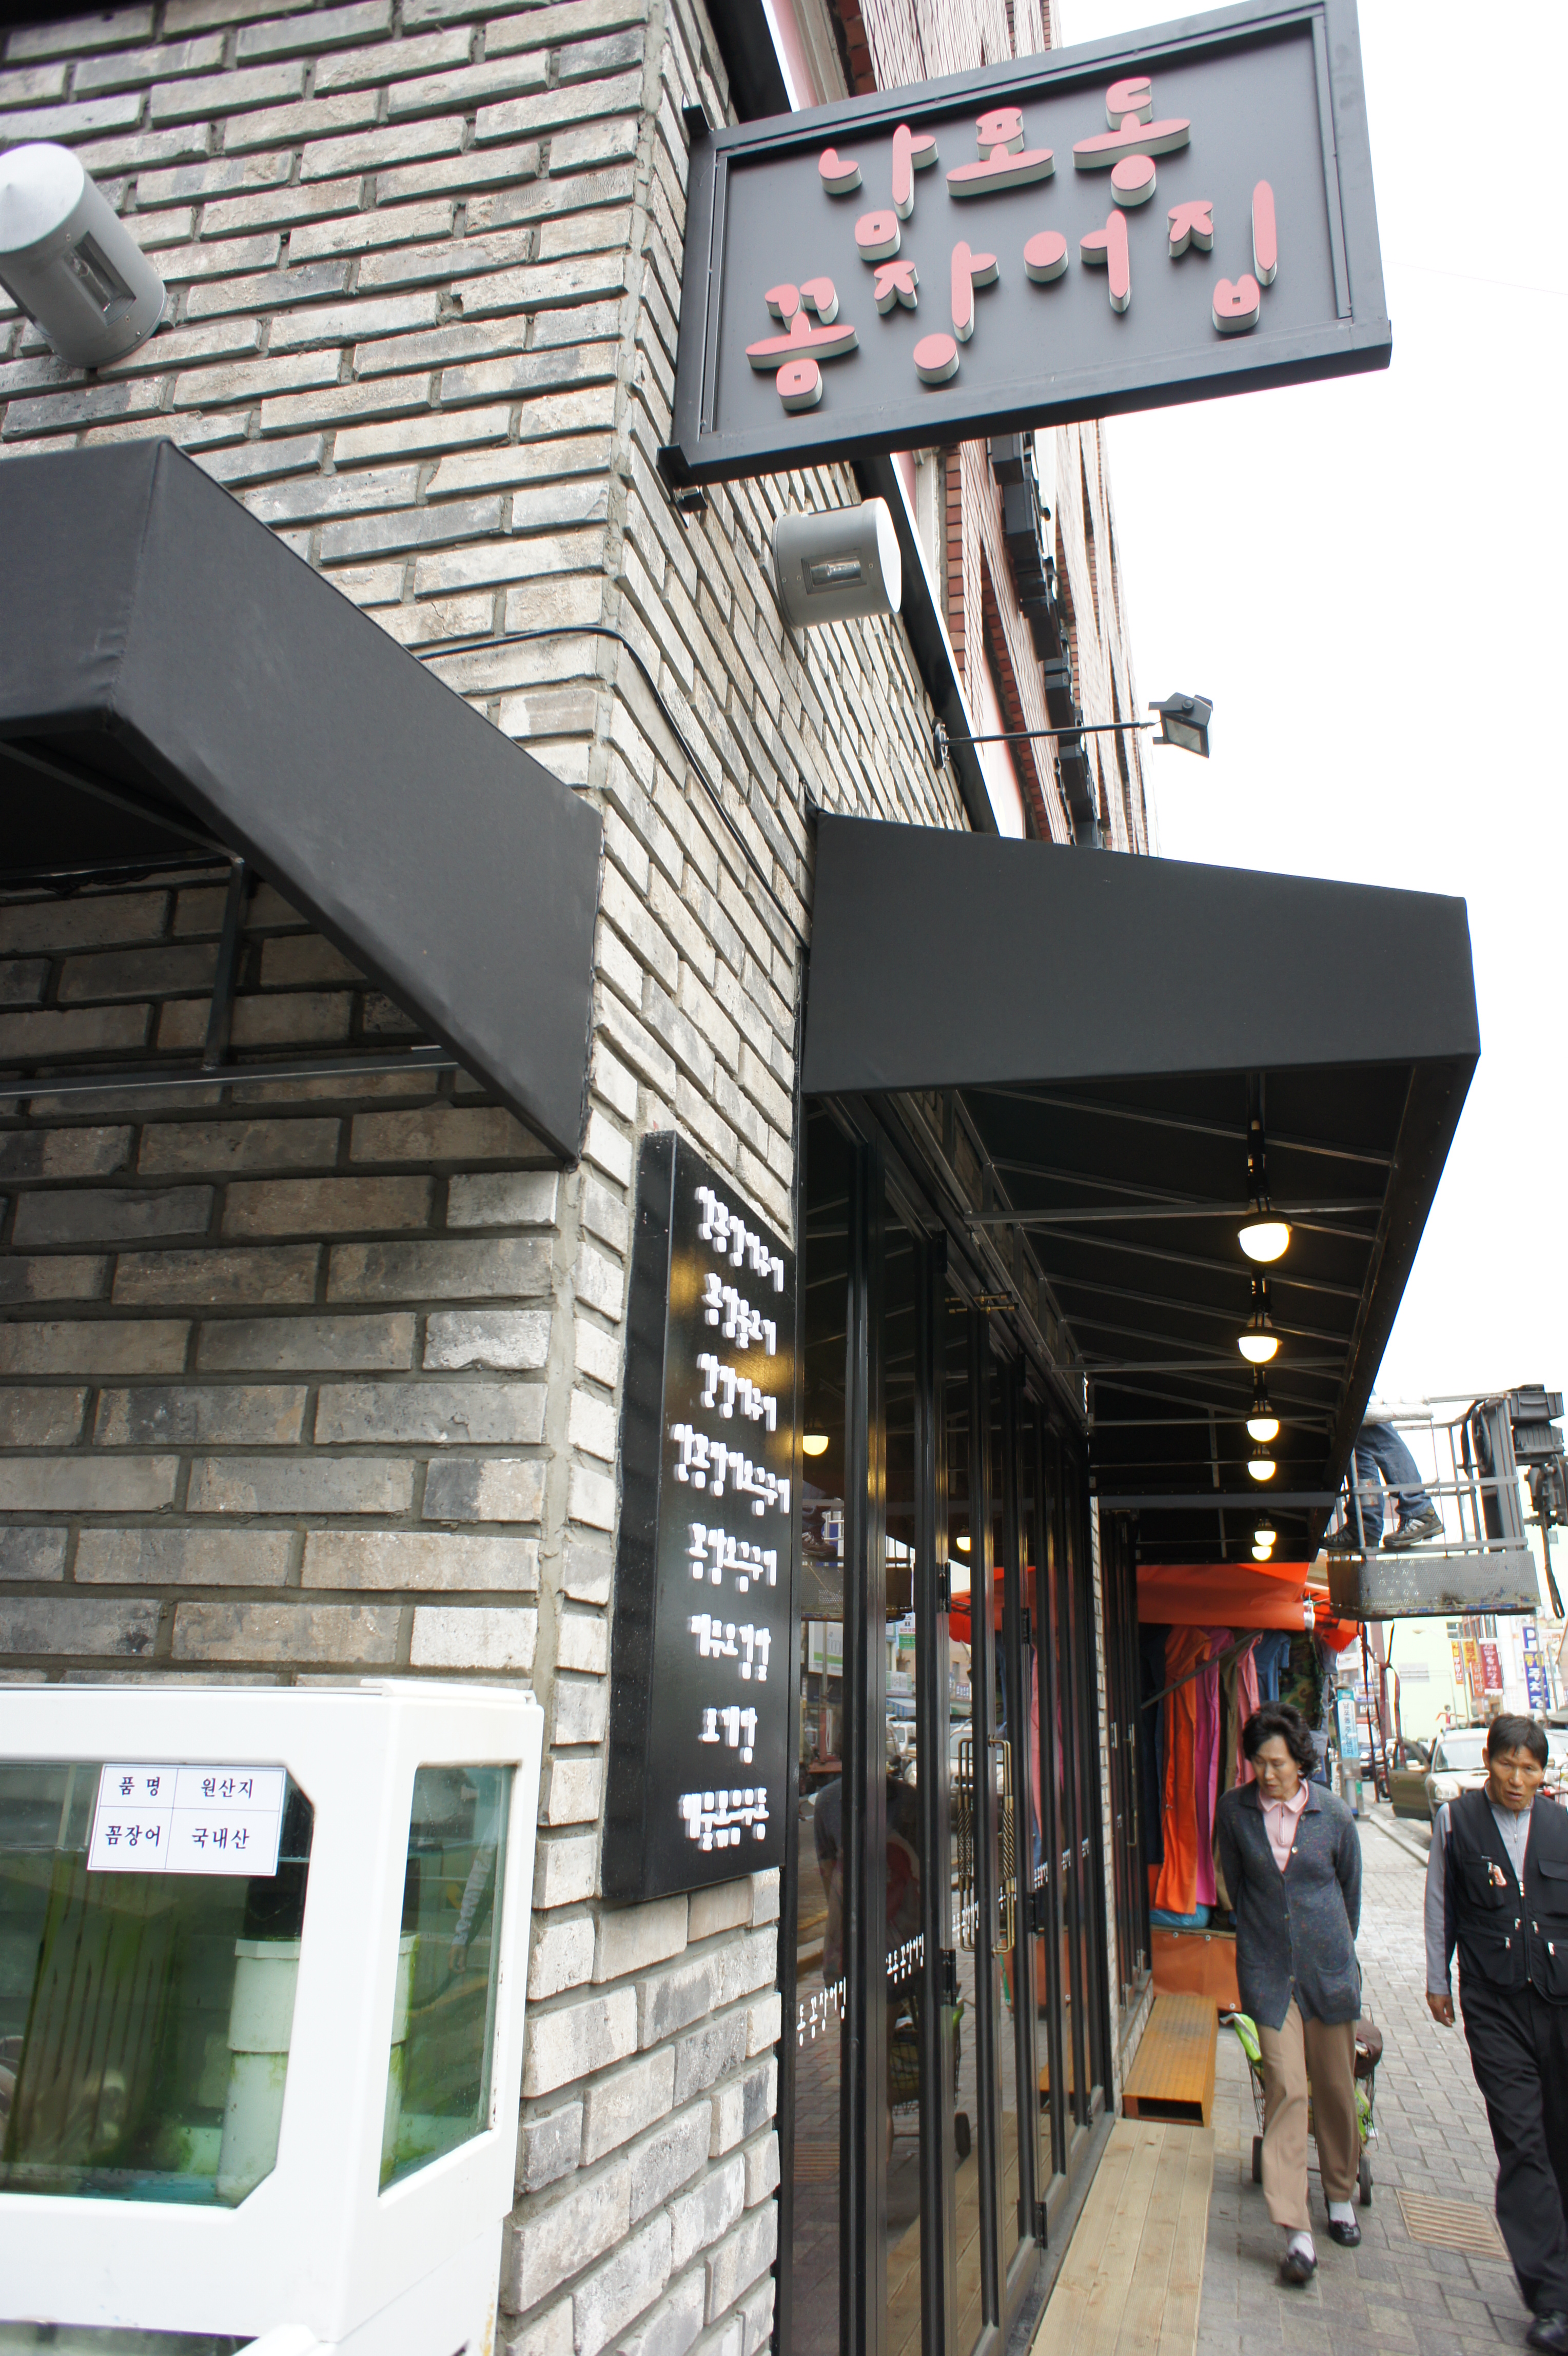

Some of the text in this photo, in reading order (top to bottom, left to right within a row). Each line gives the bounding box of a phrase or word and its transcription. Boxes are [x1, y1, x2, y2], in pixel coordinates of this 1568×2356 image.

[818, 76, 1191, 251] 남포동
[746, 180, 1278, 403] 꼼장어집
[105, 1824, 249, 1850] 꼼장어 국내산
[201, 1777, 253, 1798] 원산지
